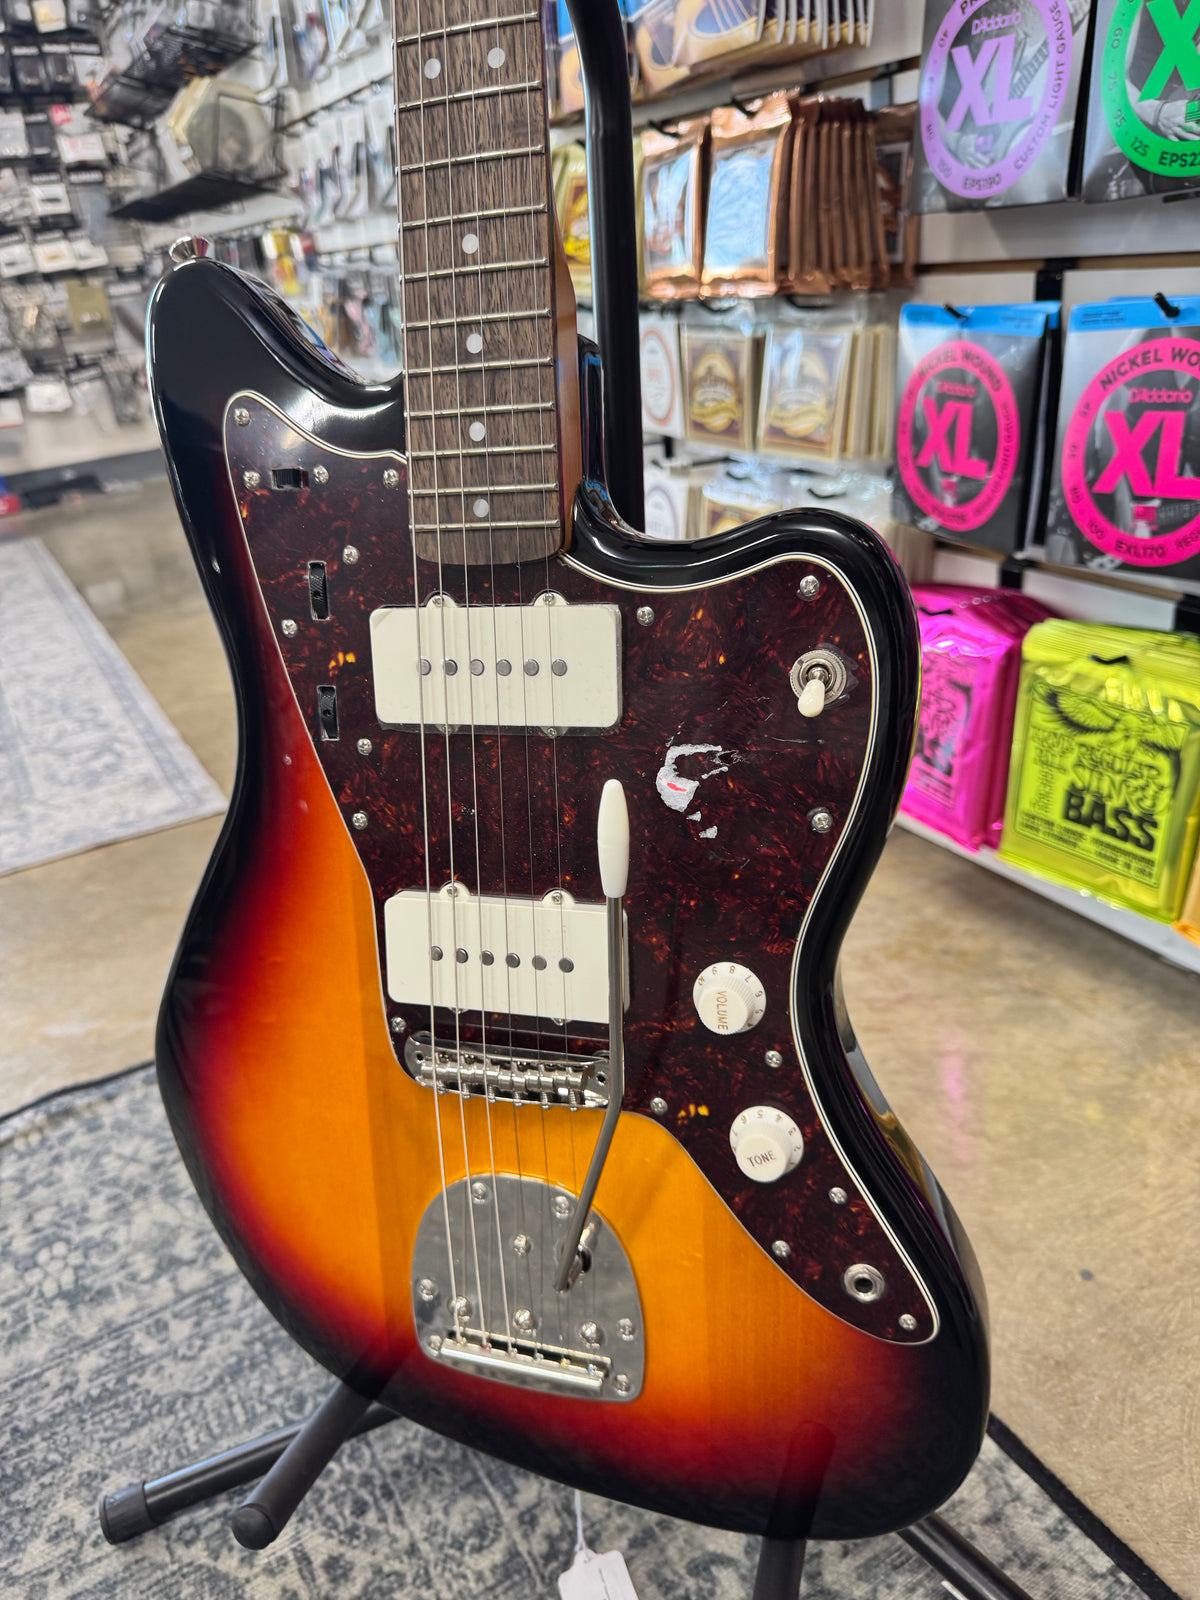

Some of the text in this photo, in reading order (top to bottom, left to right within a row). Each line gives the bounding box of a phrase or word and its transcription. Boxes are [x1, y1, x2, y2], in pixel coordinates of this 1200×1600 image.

[946, 34, 1033, 132] XL
[1013, 1, 1066, 169] CUSTOM LIGHT GAUGE
[1112, 109, 1126, 128] 95
[1130, 136, 1150, 158] 125
[1158, 150, 1200, 168] EPS2
[1099, 346, 1200, 391] NICKEL WO
[916, 397, 988, 480] XL
[1091, 410, 1200, 500] XL
[1115, 540, 1166, 558] EXL170
[1175, 529, 1200, 549] REG
[1064, 788, 1158, 852] BASS
[729, 965, 736, 975] 8
[744, 974, 752, 983] 7
[716, 990, 728, 1031] VOLUME
[757, 1109, 763, 1119] 5
[746, 1150, 777, 1168] TONE
